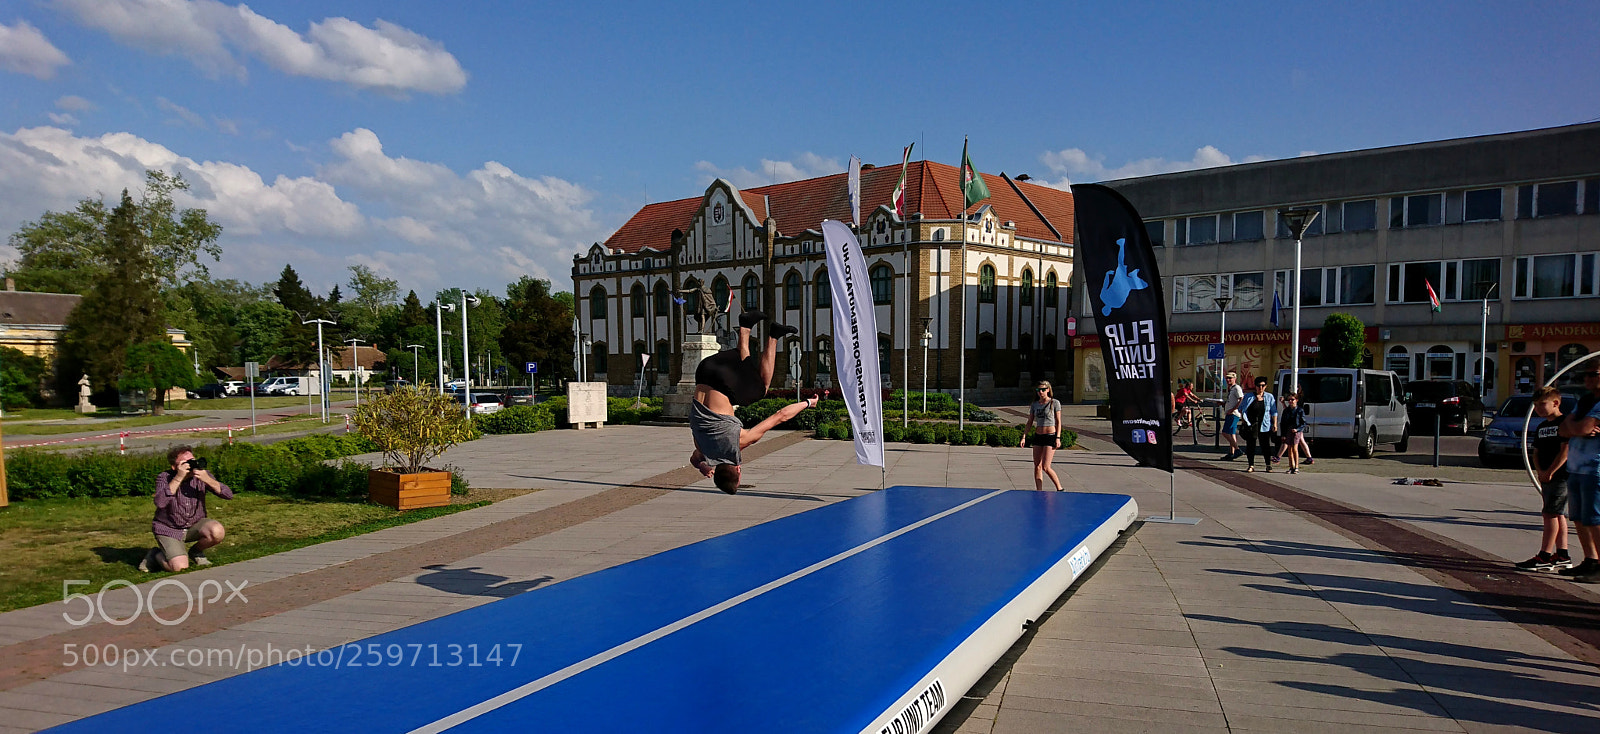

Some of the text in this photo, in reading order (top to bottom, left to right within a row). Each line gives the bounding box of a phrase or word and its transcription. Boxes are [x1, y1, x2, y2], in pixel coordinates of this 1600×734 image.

[528, 363, 535, 372] P
[901, 699, 923, 734] UNIT
[920, 681, 945, 722] TEAM
